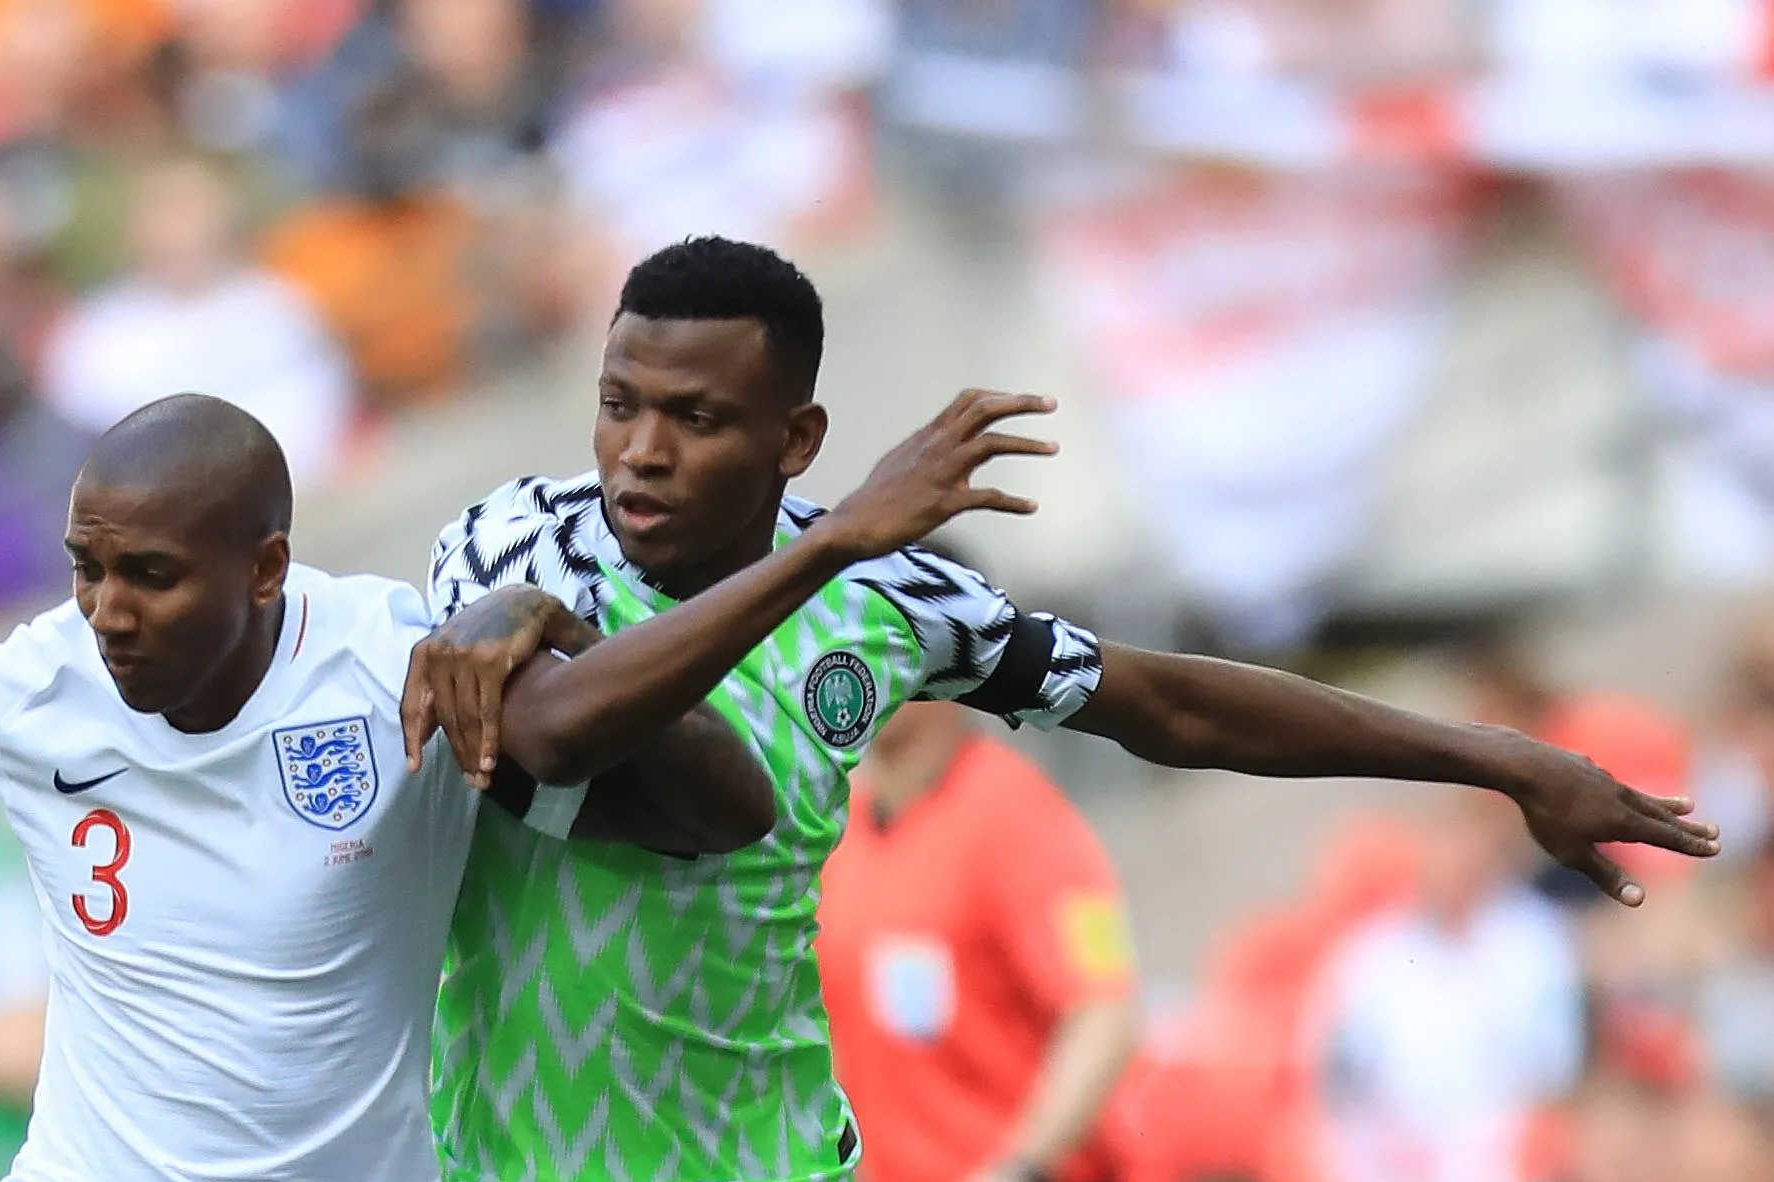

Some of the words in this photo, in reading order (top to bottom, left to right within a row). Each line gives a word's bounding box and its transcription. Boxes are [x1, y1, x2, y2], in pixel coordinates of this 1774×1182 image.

[809, 655, 848, 691] FOOTBALL
[848, 657, 876, 723] FEDERATION
[70, 806, 131, 937] 3
